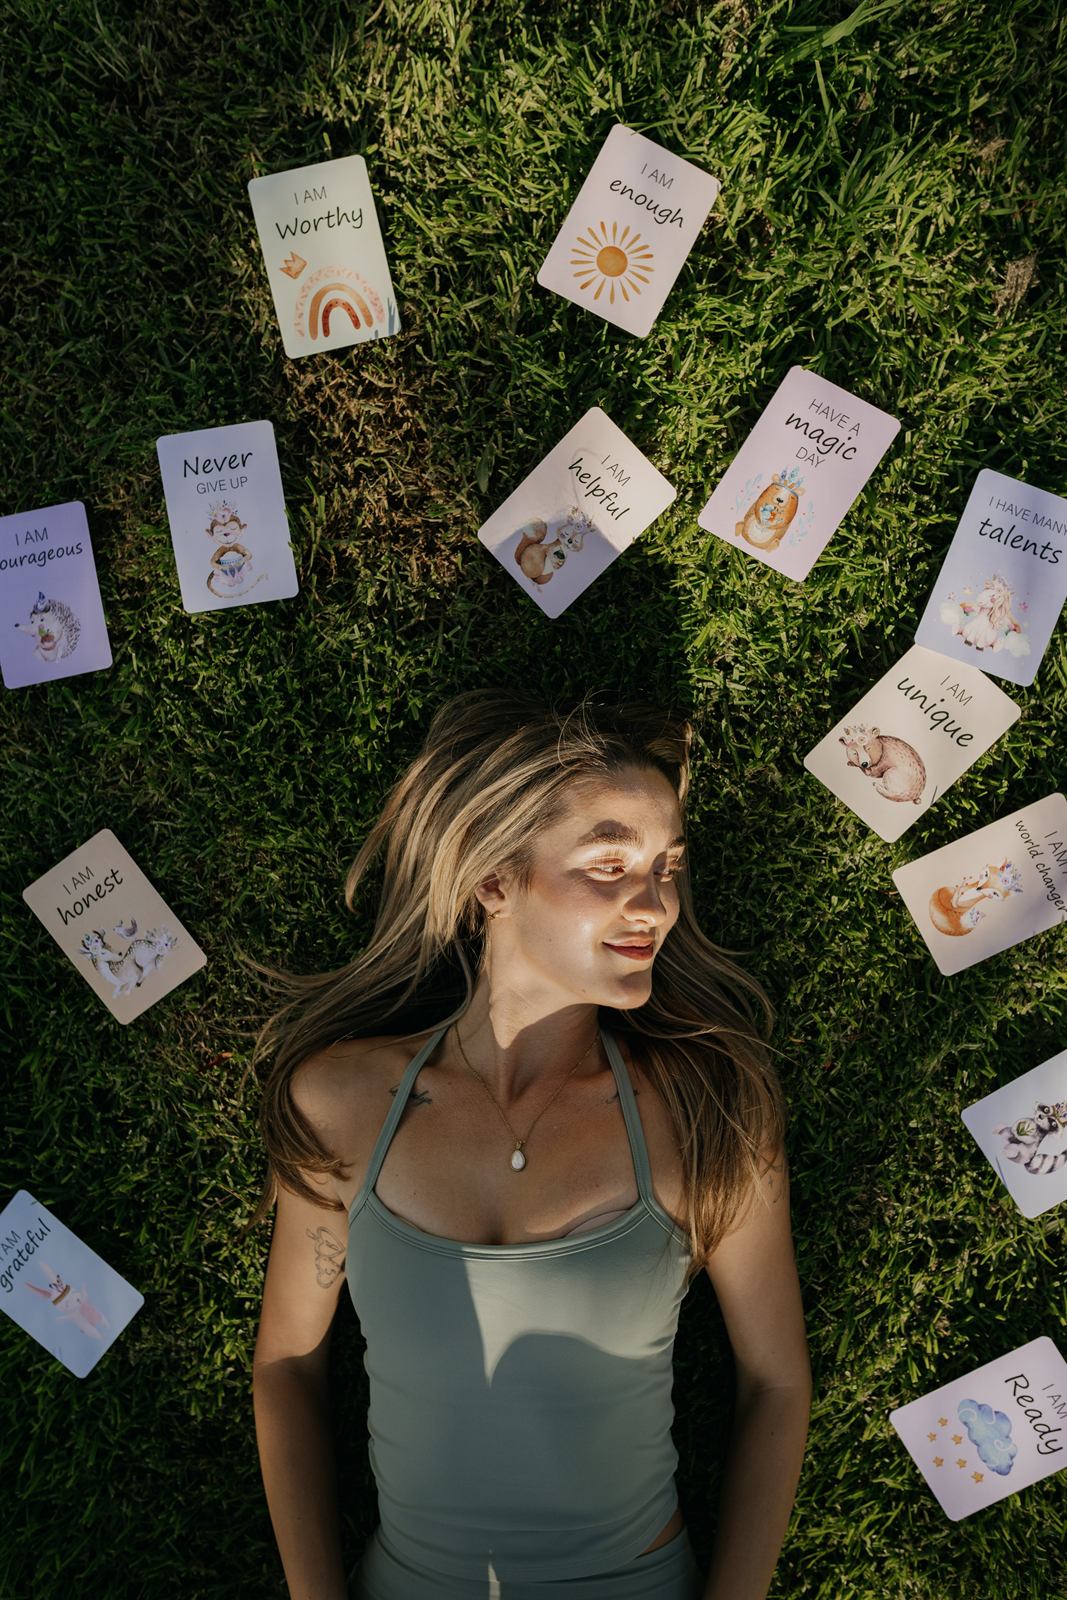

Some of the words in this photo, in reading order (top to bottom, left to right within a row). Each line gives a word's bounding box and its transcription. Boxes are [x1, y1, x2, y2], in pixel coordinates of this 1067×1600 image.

[641, 163, 648, 175] I
[647, 168, 674, 190] AM
[294, 192, 299, 205] I
[303, 186, 327, 204] AM
[609, 179, 684, 229] enough
[275, 206, 363, 239] Worthy
[808, 398, 850, 429] HAVE
[848, 422, 861, 437] A
[785, 413, 857, 460] magic
[184, 452, 253, 478] Never
[601, 454, 611, 465] I
[606, 463, 631, 487] AM
[795, 446, 825, 468] DAY
[196, 479, 227, 495] GIVE
[229, 476, 248, 490] UP
[568, 457, 631, 521] helpful
[988, 496, 995, 507] I
[995, 498, 1032, 521] HAVE
[15, 533, 19, 546] I
[24, 527, 48, 545] AM
[979, 518, 1063, 564] talents
[0, 542, 83, 570] ourageous
[940, 675, 951, 686] I
[946, 683, 973, 706] AM
[897, 677, 974, 747] unique
[62, 884, 71, 895] I
[72, 865, 95, 890] AM
[1015, 820, 1044, 859] world
[1035, 862, 1067, 912] changer
[57, 868, 124, 926] honest
[0, 1217, 51, 1293] grateful
[1, 1230, 21, 1255] AM
[1041, 1383, 1055, 1391] I
[1004, 1373, 1063, 1455] Ready
[1046, 1394, 1067, 1420] AM
